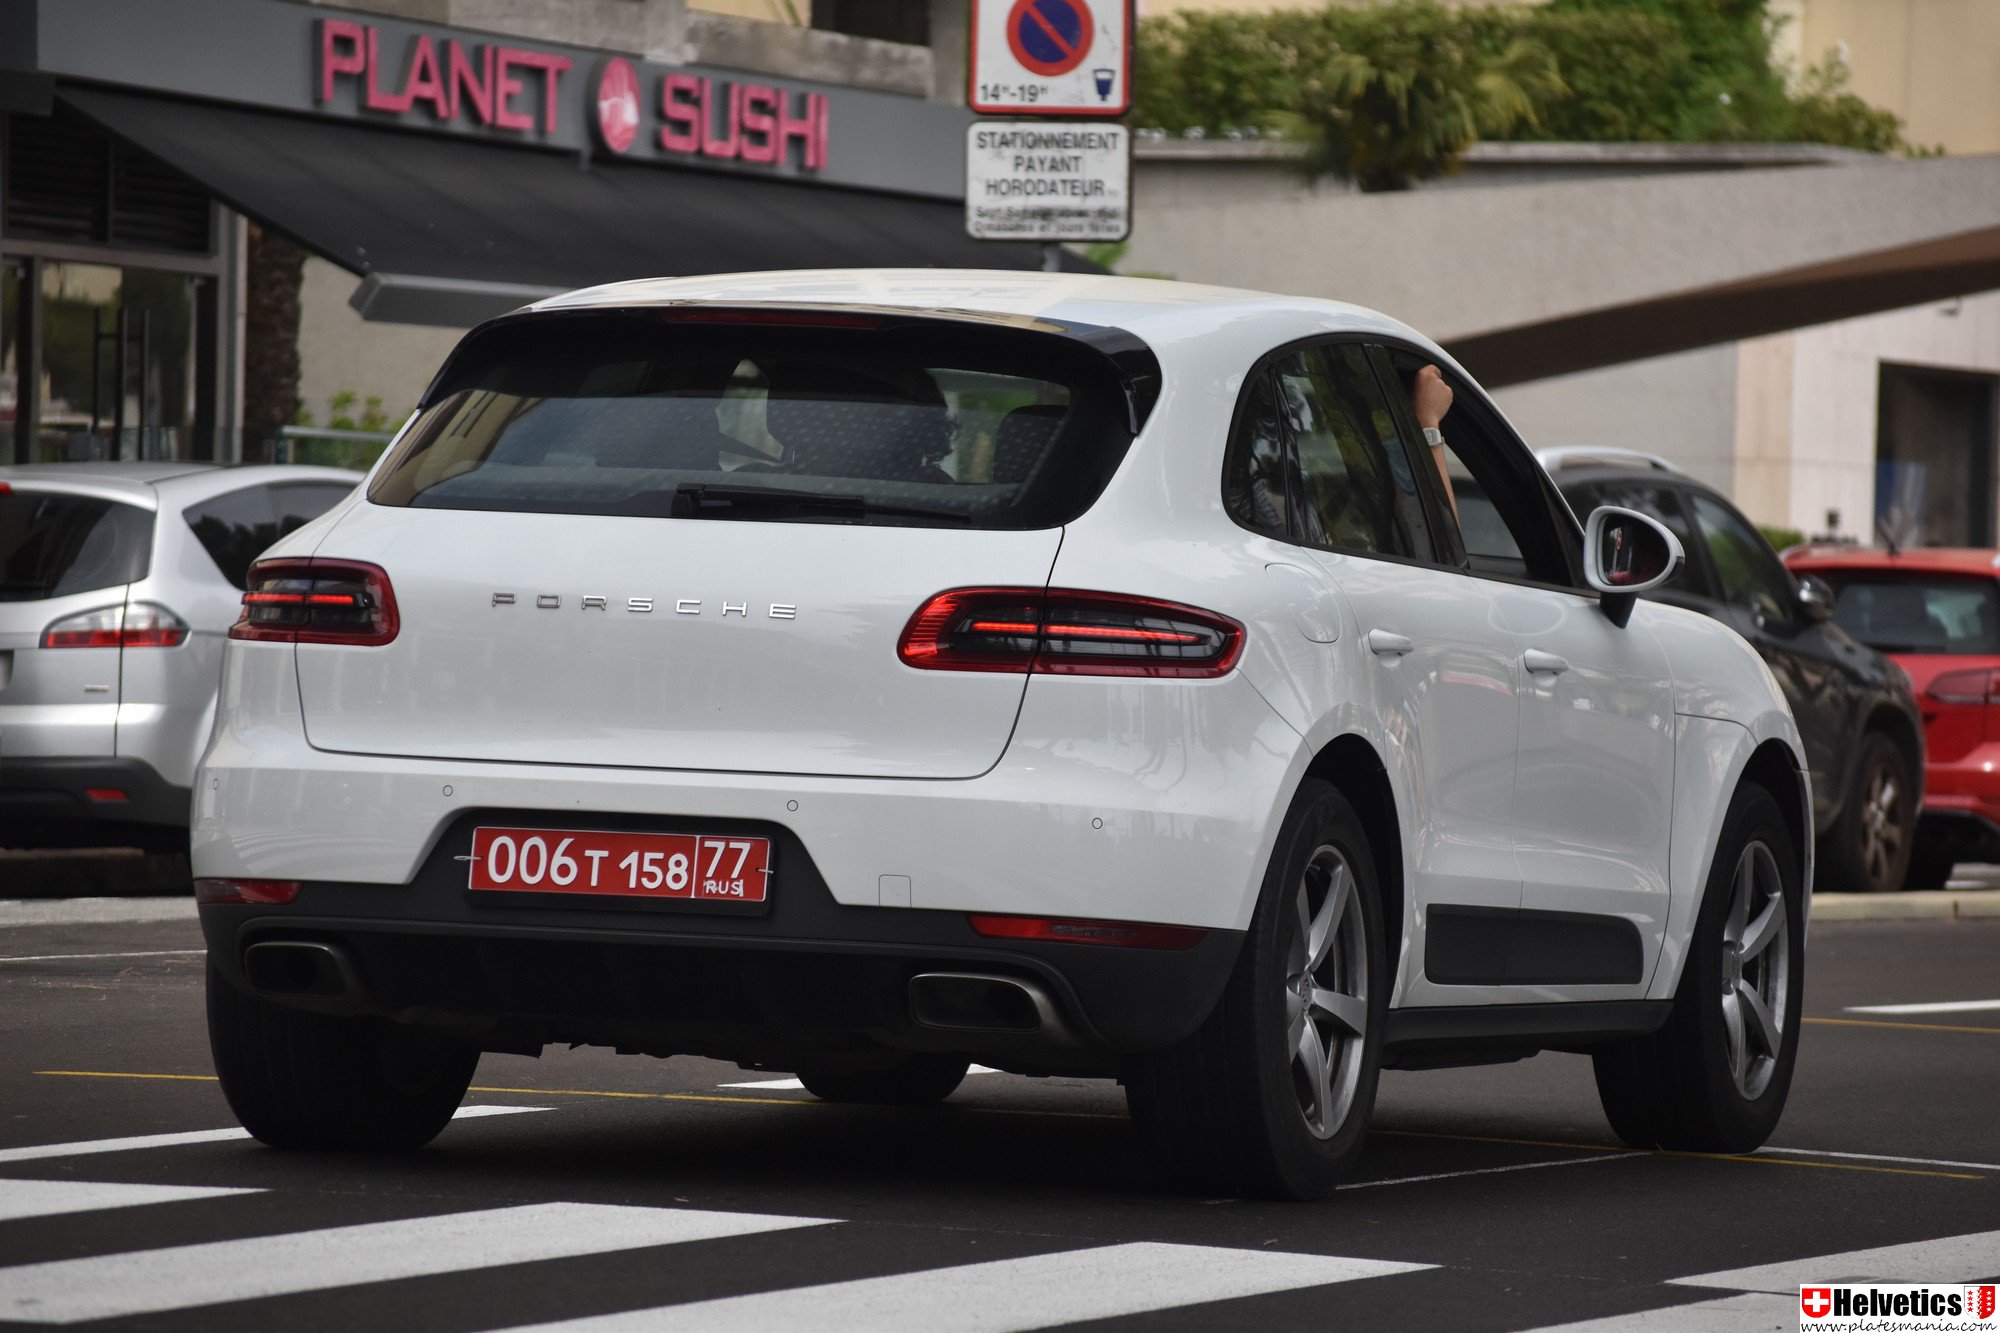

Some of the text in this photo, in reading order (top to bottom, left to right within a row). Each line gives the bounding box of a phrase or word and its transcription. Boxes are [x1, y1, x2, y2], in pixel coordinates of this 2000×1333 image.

[321, 19, 829, 170] PLANET SUSHI
[977, 131, 1120, 149] STATIONNEMENT
[1014, 155, 1082, 173] PAYANT
[986, 179, 1105, 196] HORODATEUR
[491, 592, 797, 619] PORSCHE
[704, 840, 751, 879] 77
